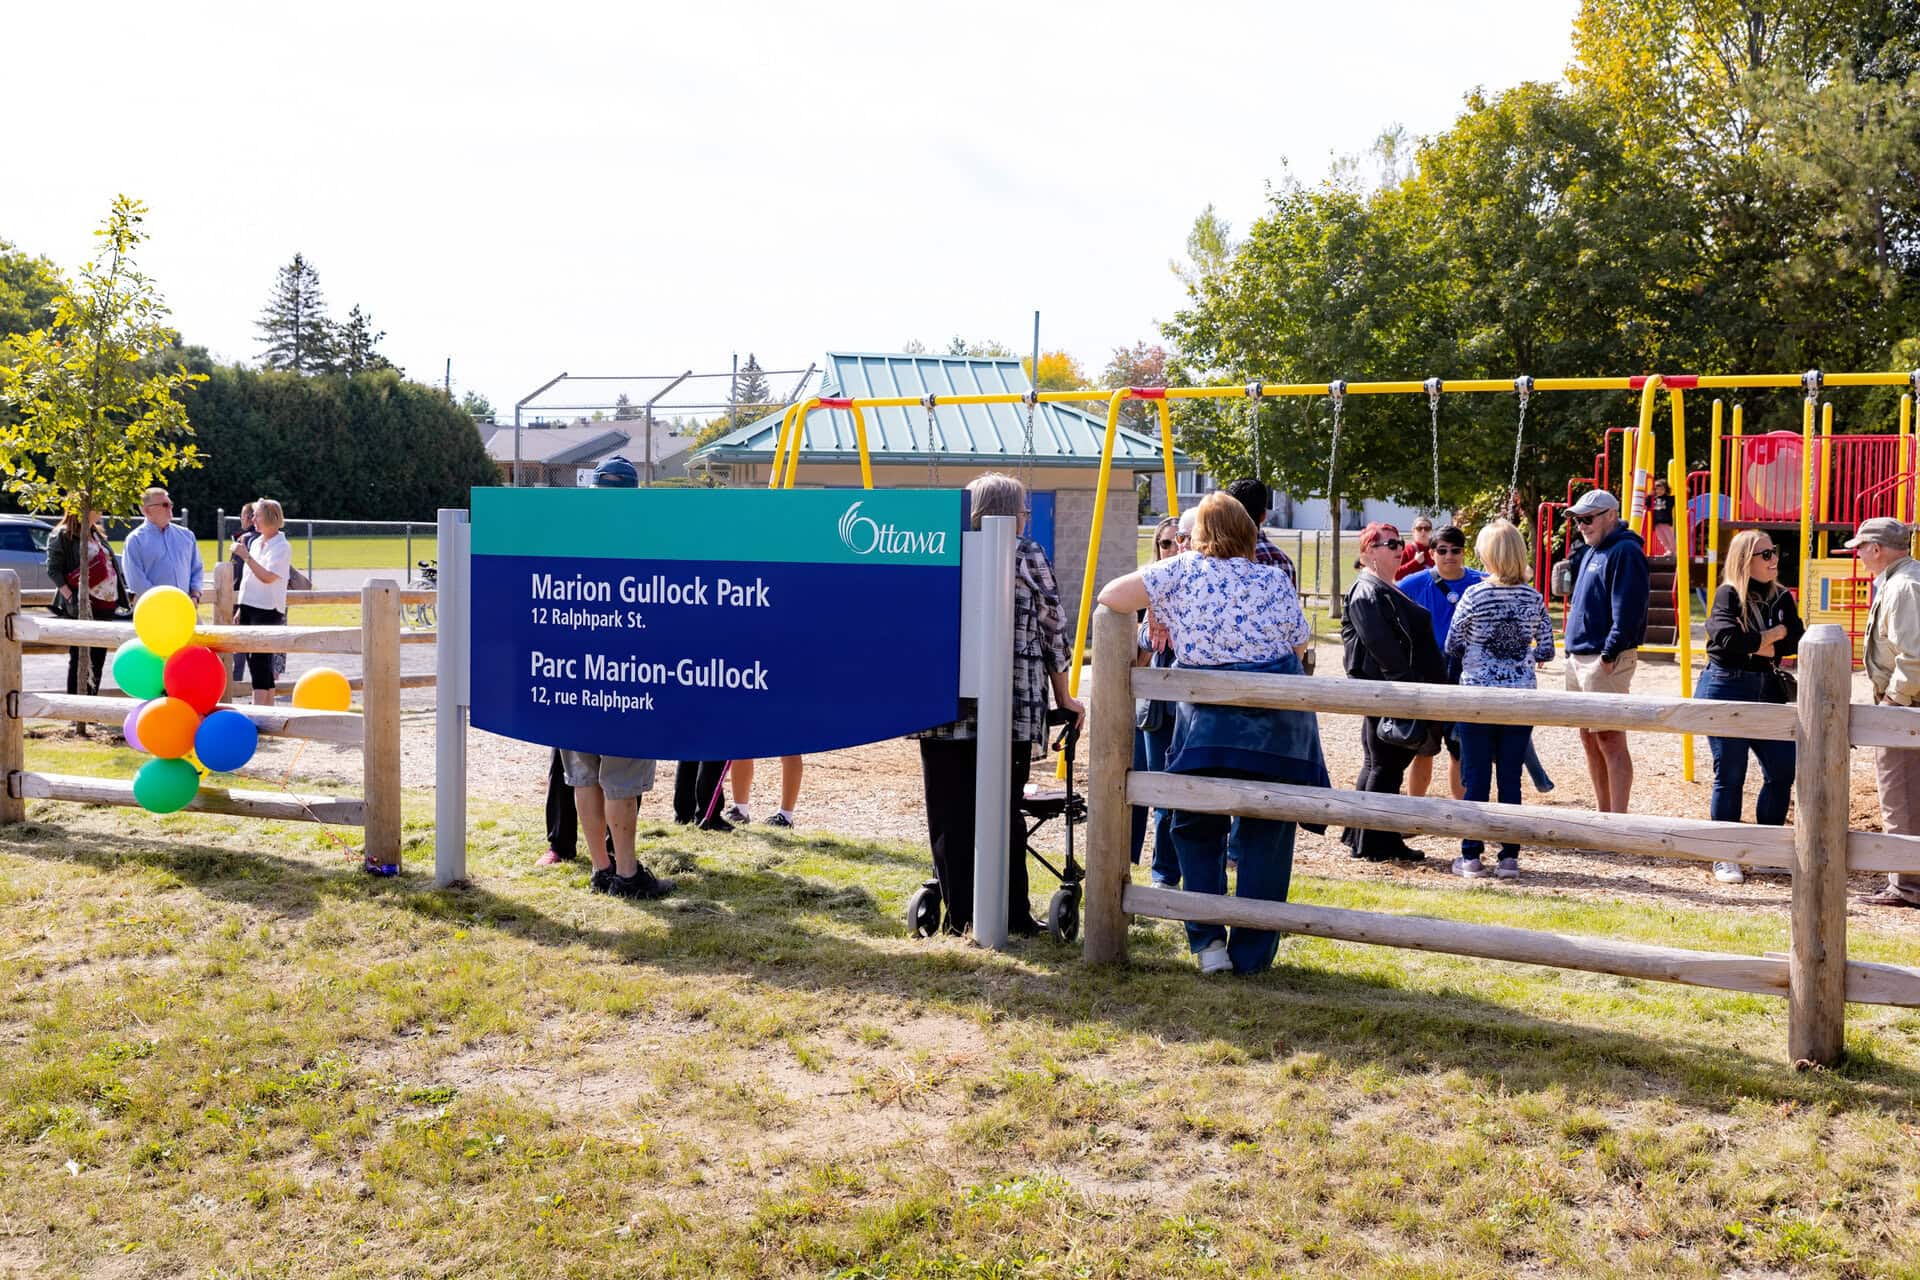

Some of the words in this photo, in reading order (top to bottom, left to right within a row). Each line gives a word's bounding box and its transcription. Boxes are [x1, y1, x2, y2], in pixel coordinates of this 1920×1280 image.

[839, 502, 946, 555] Ottawa
[532, 573, 611, 602] Marion
[619, 575, 709, 606] Gullock
[717, 577, 770, 608] Park
[531, 608, 548, 625] 12
[552, 608, 623, 631] Ralphpark
[627, 611, 646, 629] St.
[531, 651, 577, 680] Parc
[584, 654, 769, 690] Marion-Gullock
[531, 686, 551, 706] 12,
[554, 691, 578, 705] rue
[582, 689, 654, 713] Ralphpark
